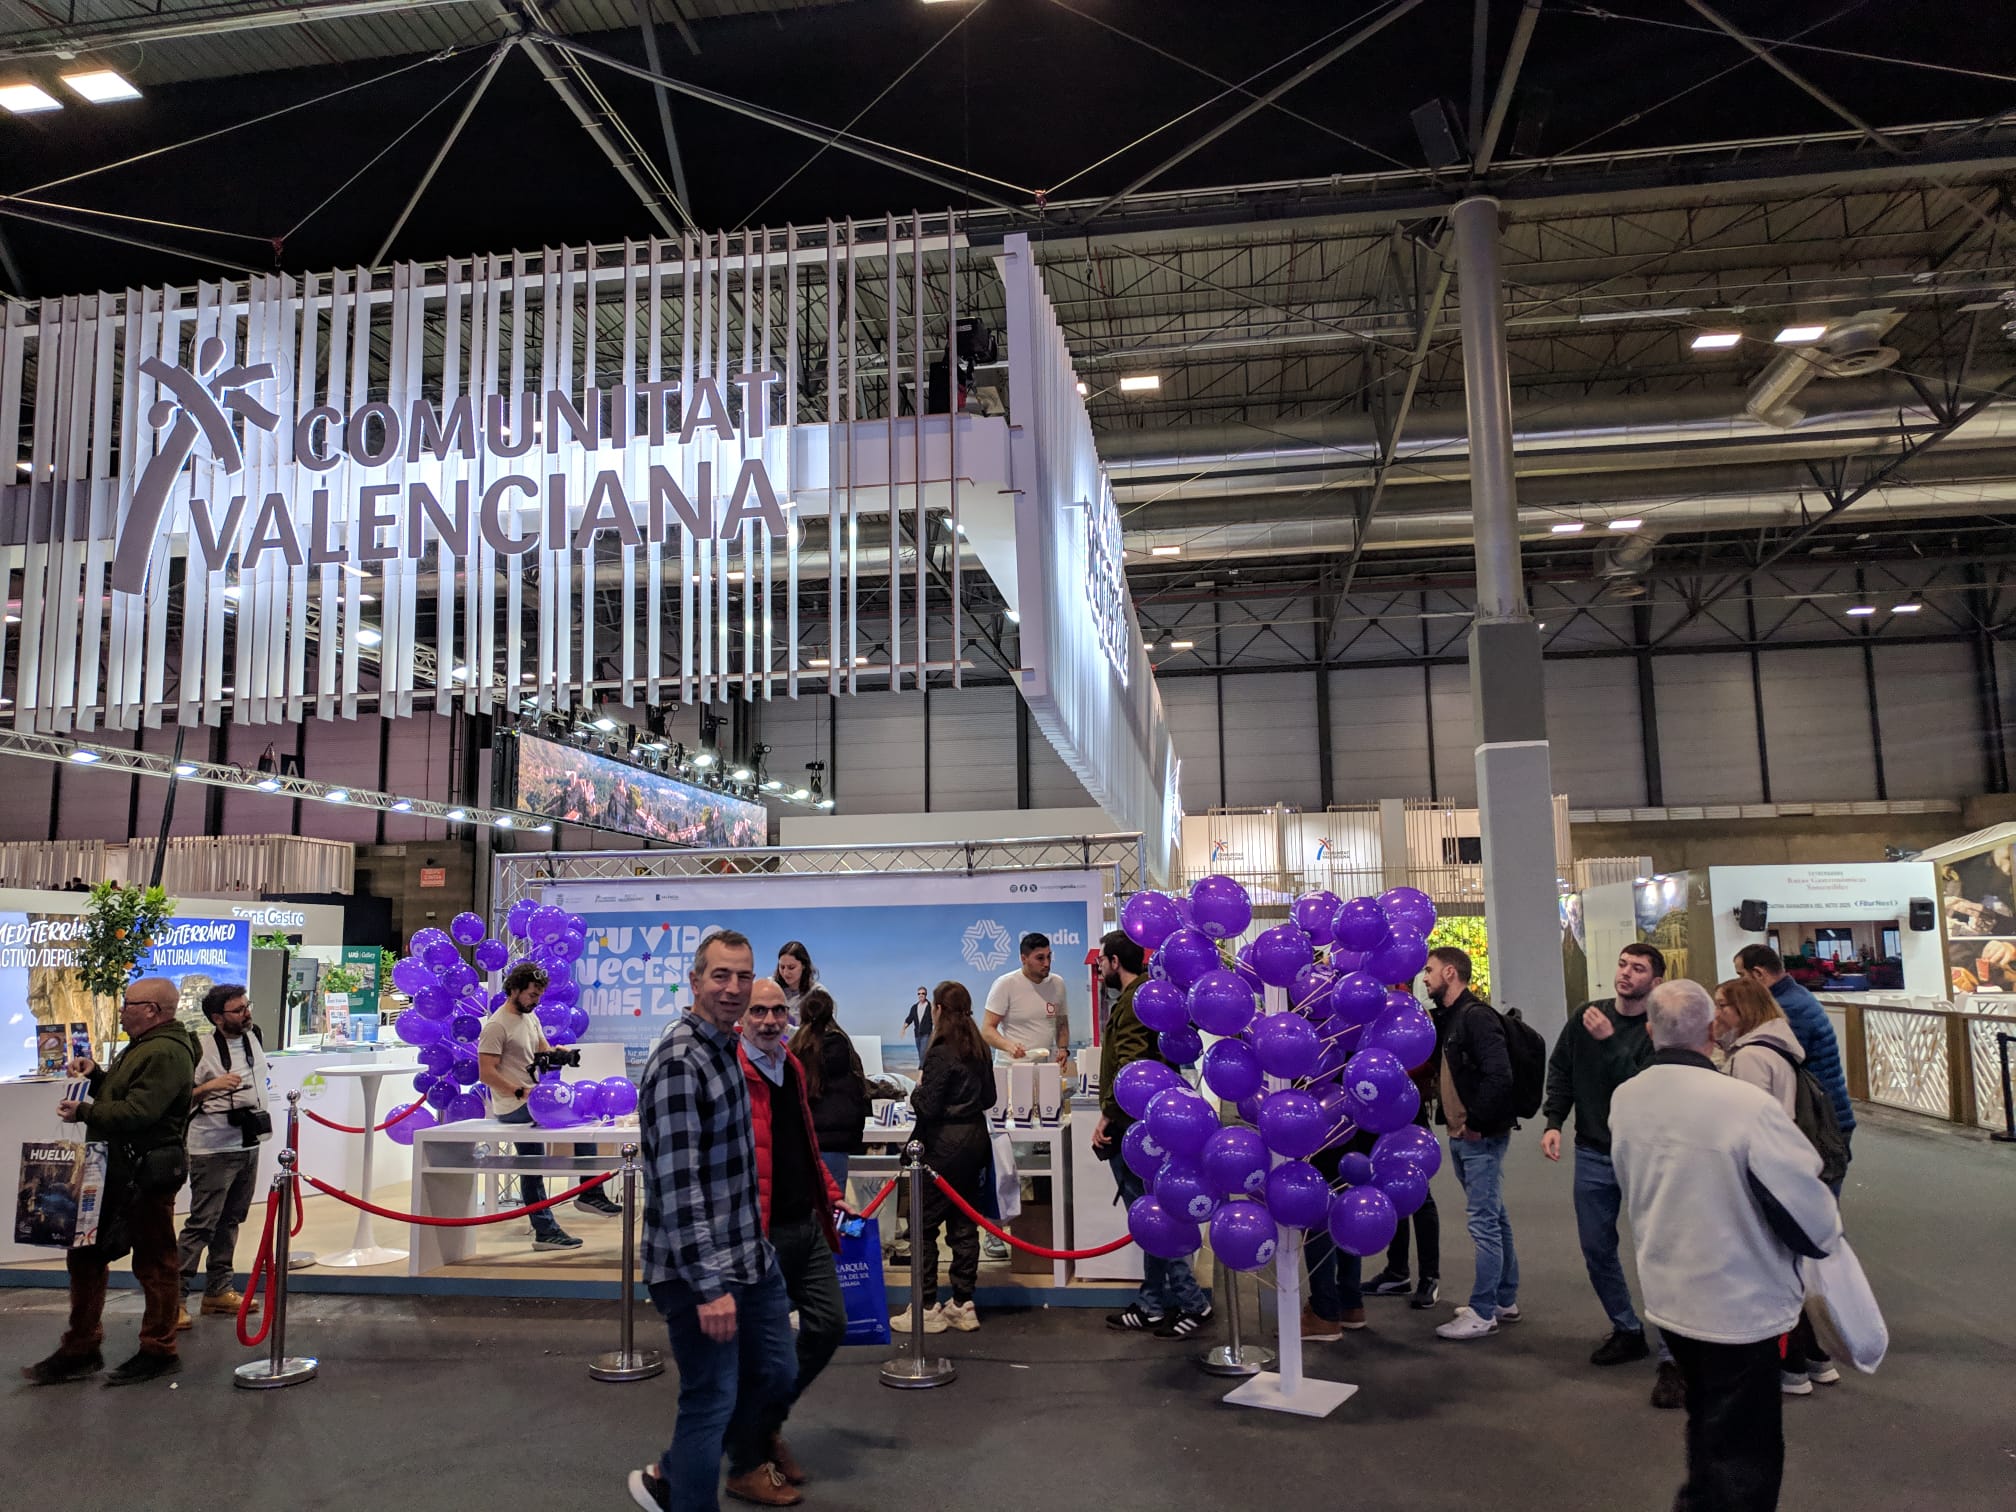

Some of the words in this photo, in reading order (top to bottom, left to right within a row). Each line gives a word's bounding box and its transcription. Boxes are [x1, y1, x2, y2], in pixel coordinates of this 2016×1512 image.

[294, 370, 779, 472] COMUNITAT
[188, 457, 789, 573] VALENCIANA
[265, 907, 306, 926] Gastro
[586, 926, 634, 955] TU
[153, 948, 228, 966] NATURAL/RURAL
[651, 987, 692, 1015] LU
[29, 1148, 77, 1162] HUELVA
